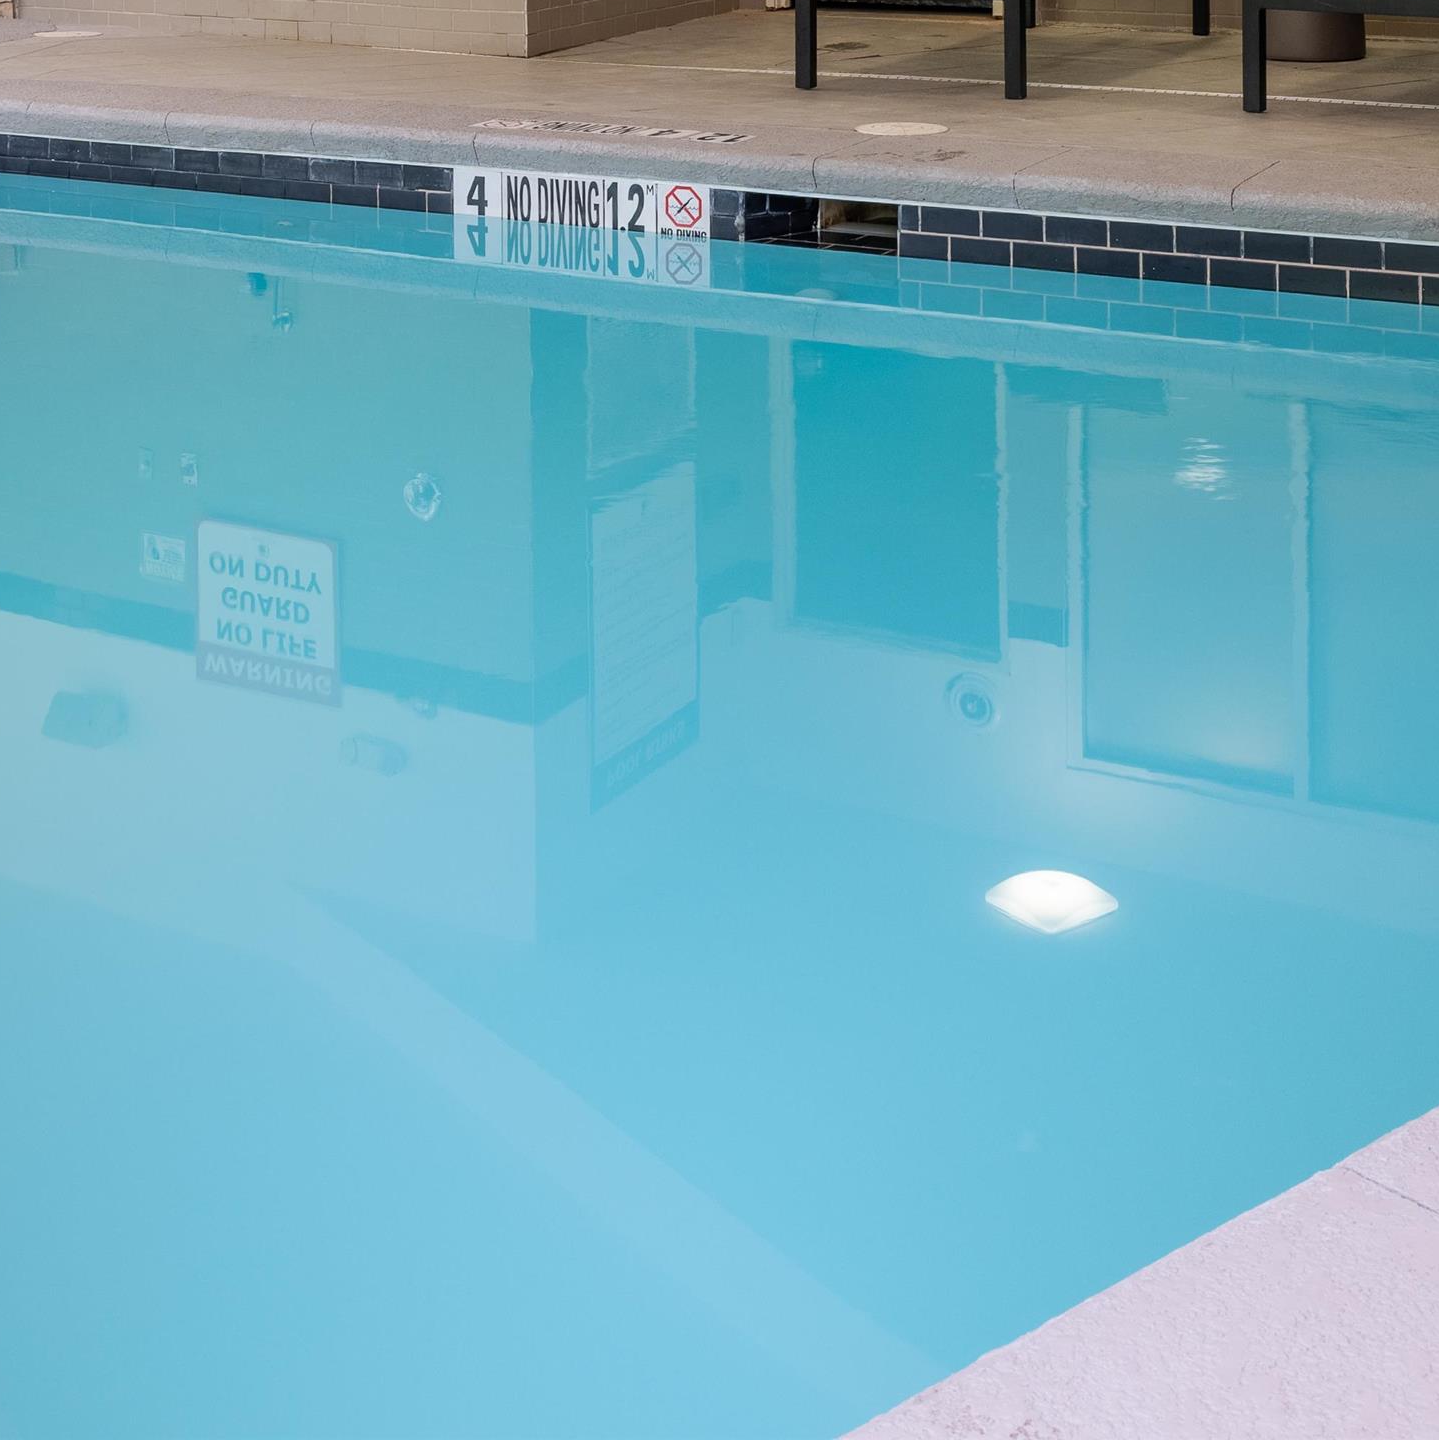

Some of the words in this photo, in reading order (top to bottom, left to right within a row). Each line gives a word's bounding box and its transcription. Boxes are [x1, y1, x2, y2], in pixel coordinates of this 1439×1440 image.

[467, 176, 488, 216] 4
[506, 176, 532, 222] NO
[538, 178, 599, 228] DIVING
[607, 182, 645, 232] 1.2
[646, 185, 654, 196] M
